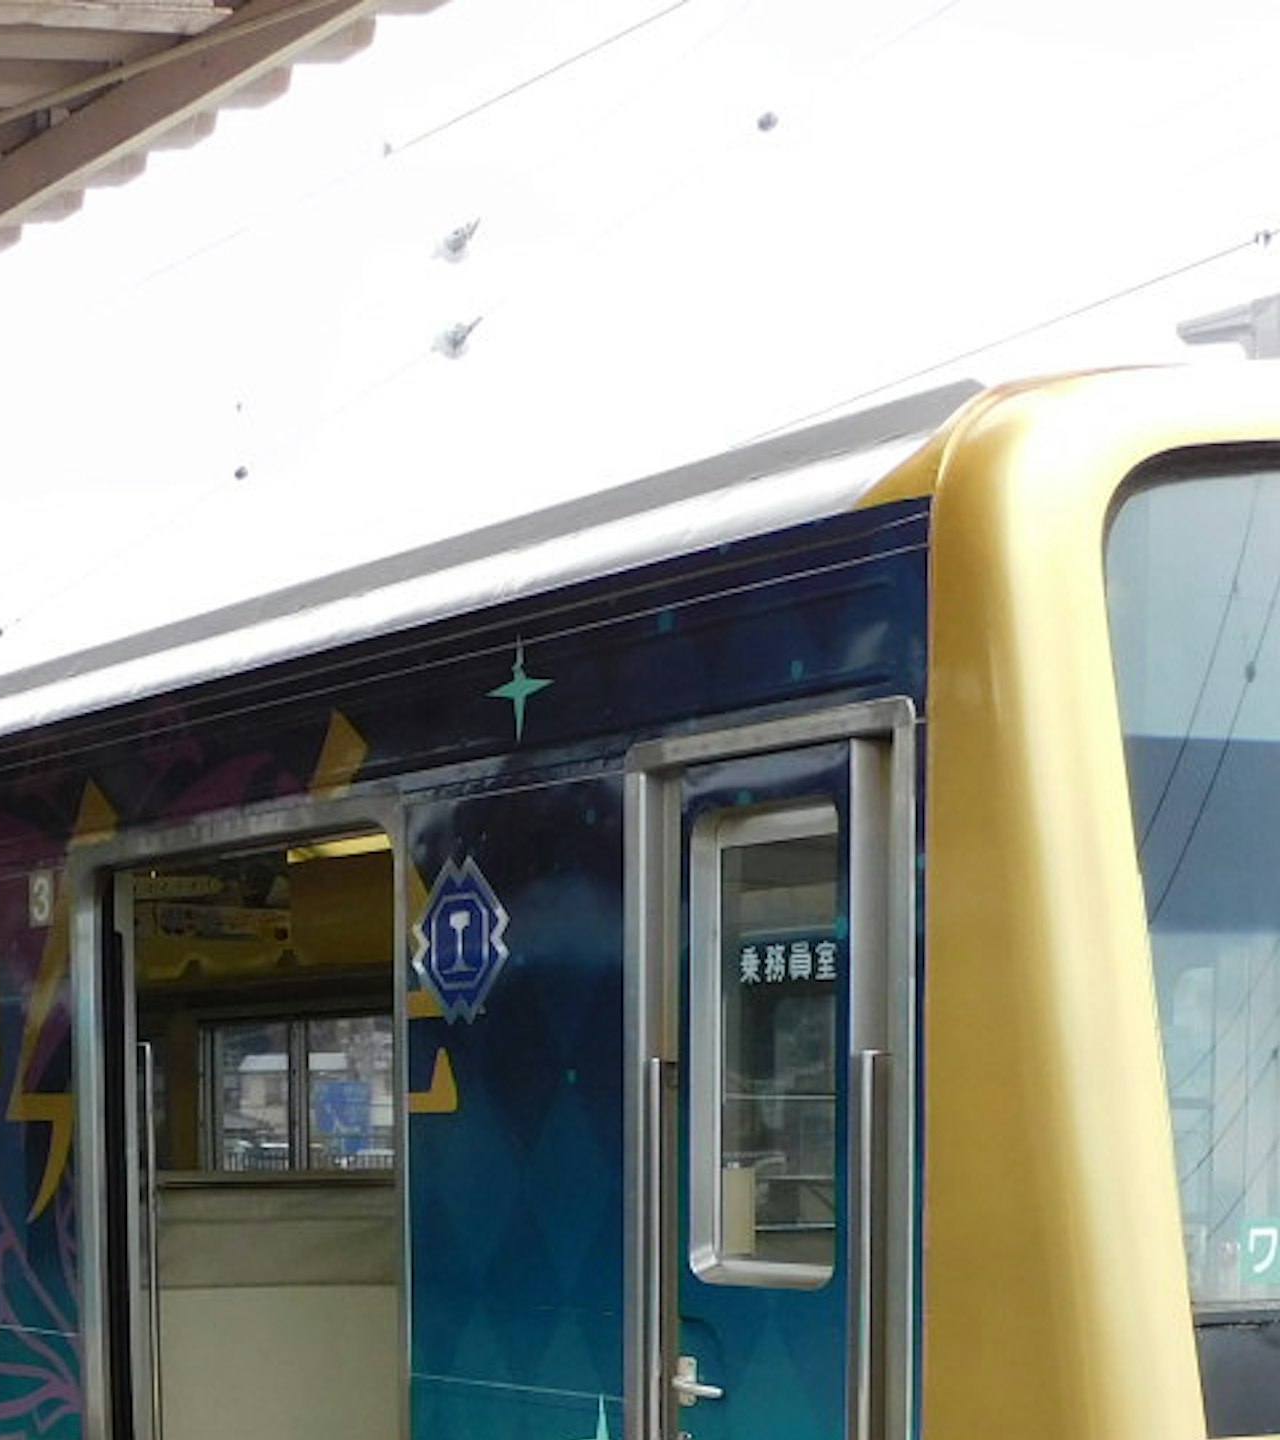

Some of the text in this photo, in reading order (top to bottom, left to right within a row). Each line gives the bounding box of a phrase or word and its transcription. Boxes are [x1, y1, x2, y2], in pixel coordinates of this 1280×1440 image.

[33, 875, 50, 922] 3
[740, 940, 838, 984] 乗務員室
